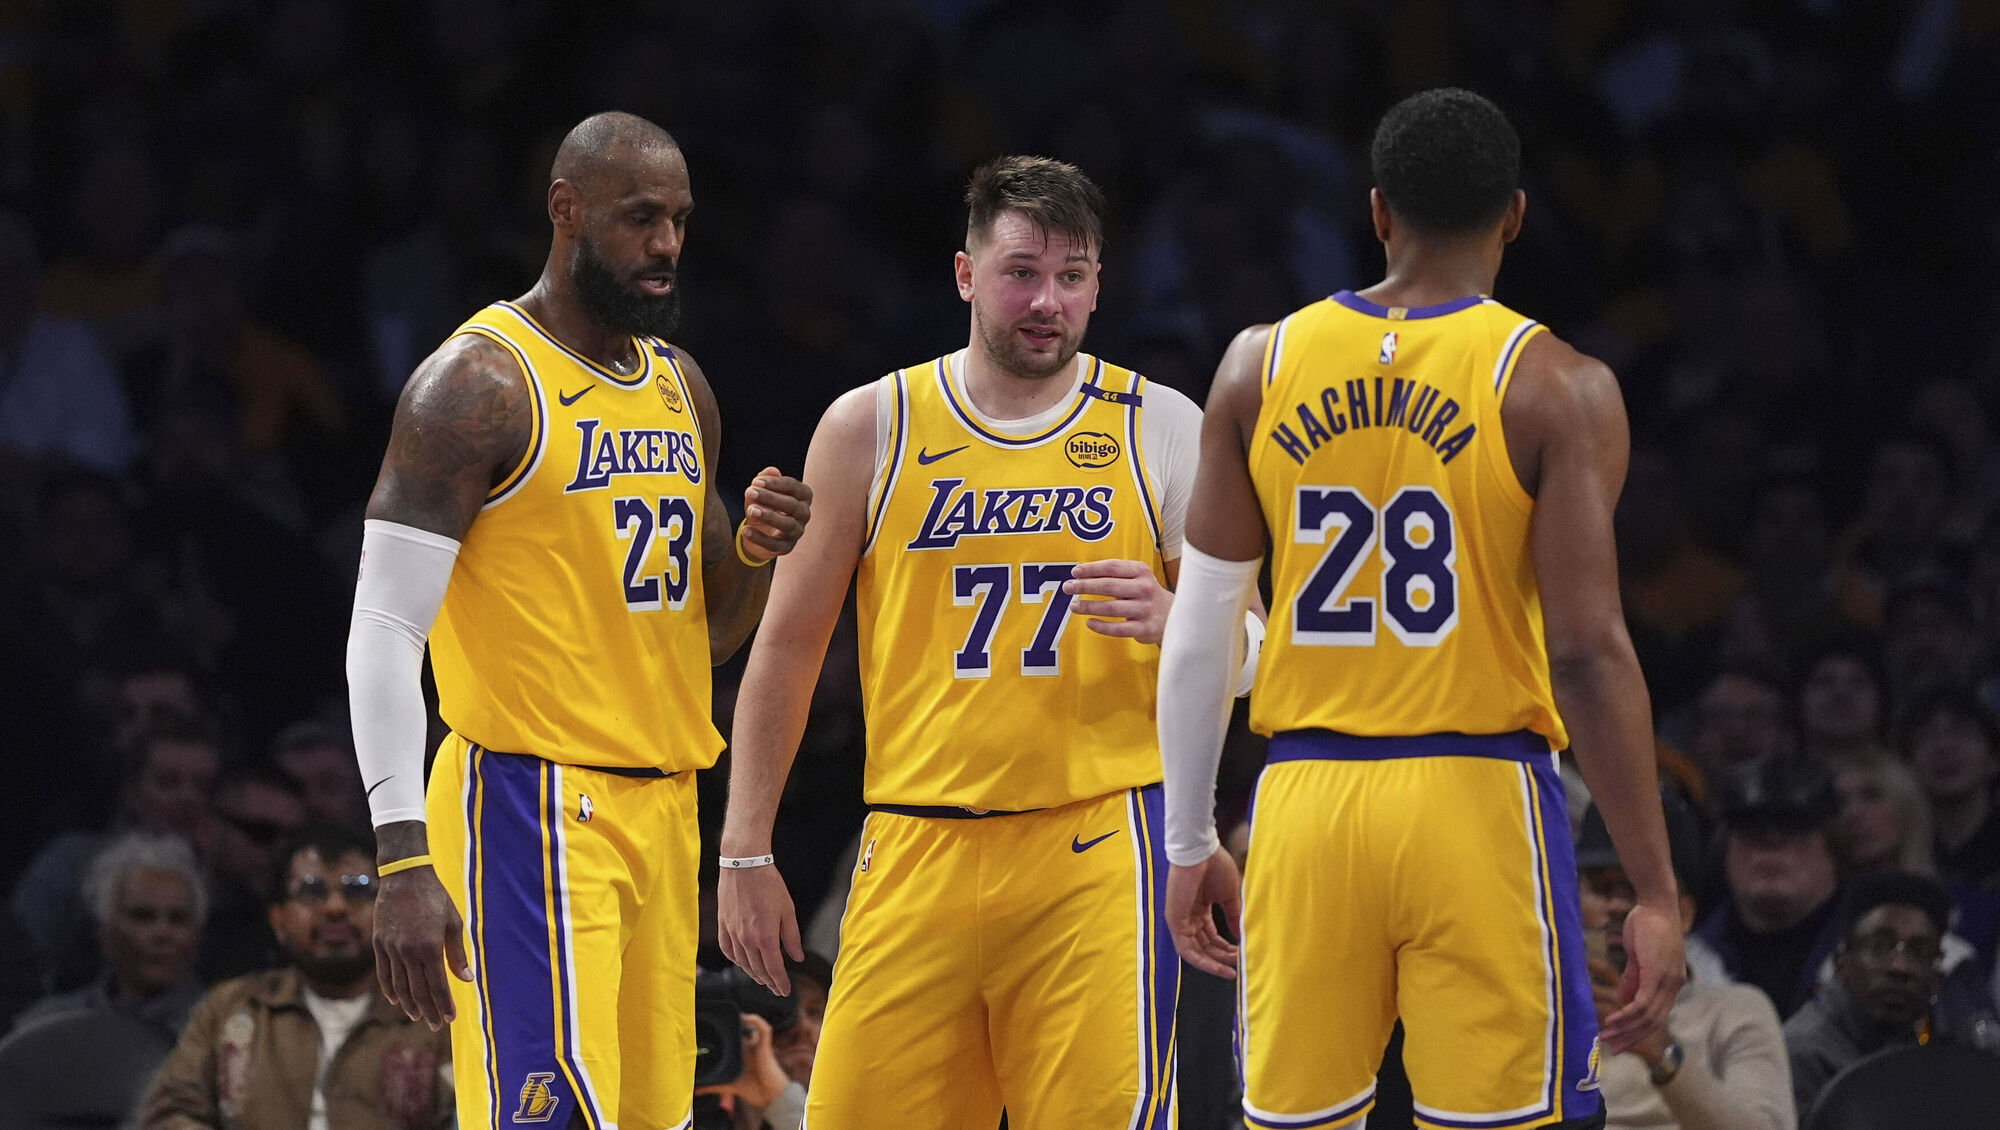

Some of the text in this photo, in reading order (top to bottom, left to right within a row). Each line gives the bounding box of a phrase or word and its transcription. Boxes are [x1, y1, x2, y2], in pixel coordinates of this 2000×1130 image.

[1102, 391, 1118, 401] 44
[1271, 377, 1477, 466] HACHIMURA
[563, 417, 701, 495] LAKERS
[1070, 441, 1117, 457] bibigo
[613, 496, 696, 612] 23
[905, 476, 1115, 551] LAKERS
[1291, 485, 1459, 647] 28
[953, 562, 1081, 679] 77
